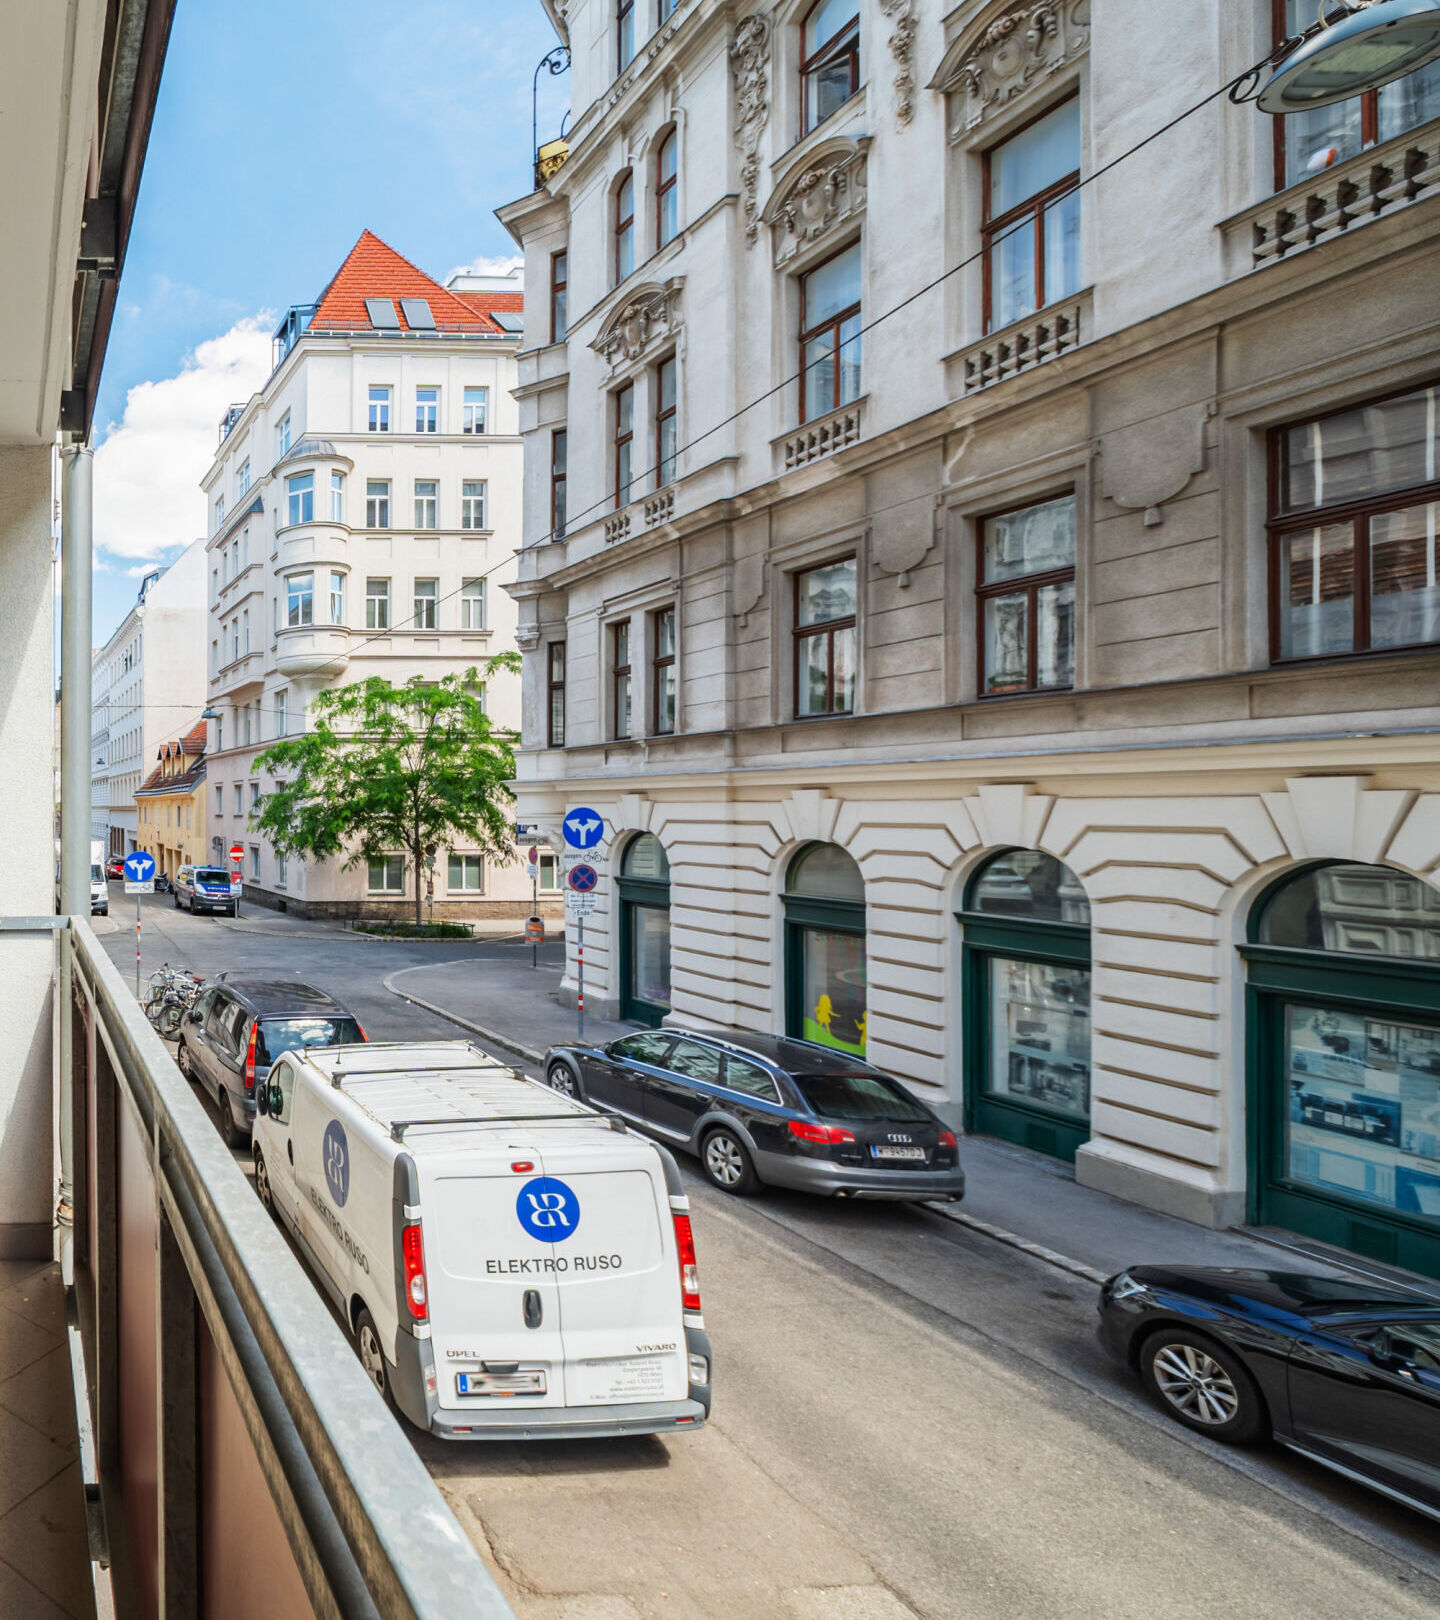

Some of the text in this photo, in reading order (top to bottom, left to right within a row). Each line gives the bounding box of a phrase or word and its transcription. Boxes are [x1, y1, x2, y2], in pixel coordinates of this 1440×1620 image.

[310, 1187, 370, 1275] ELEKTRO RUSO
[486, 1254, 622, 1274] ELEKTRO RUSO
[446, 1350, 481, 1358] OPEL
[636, 1343, 677, 1352] VIVARO
